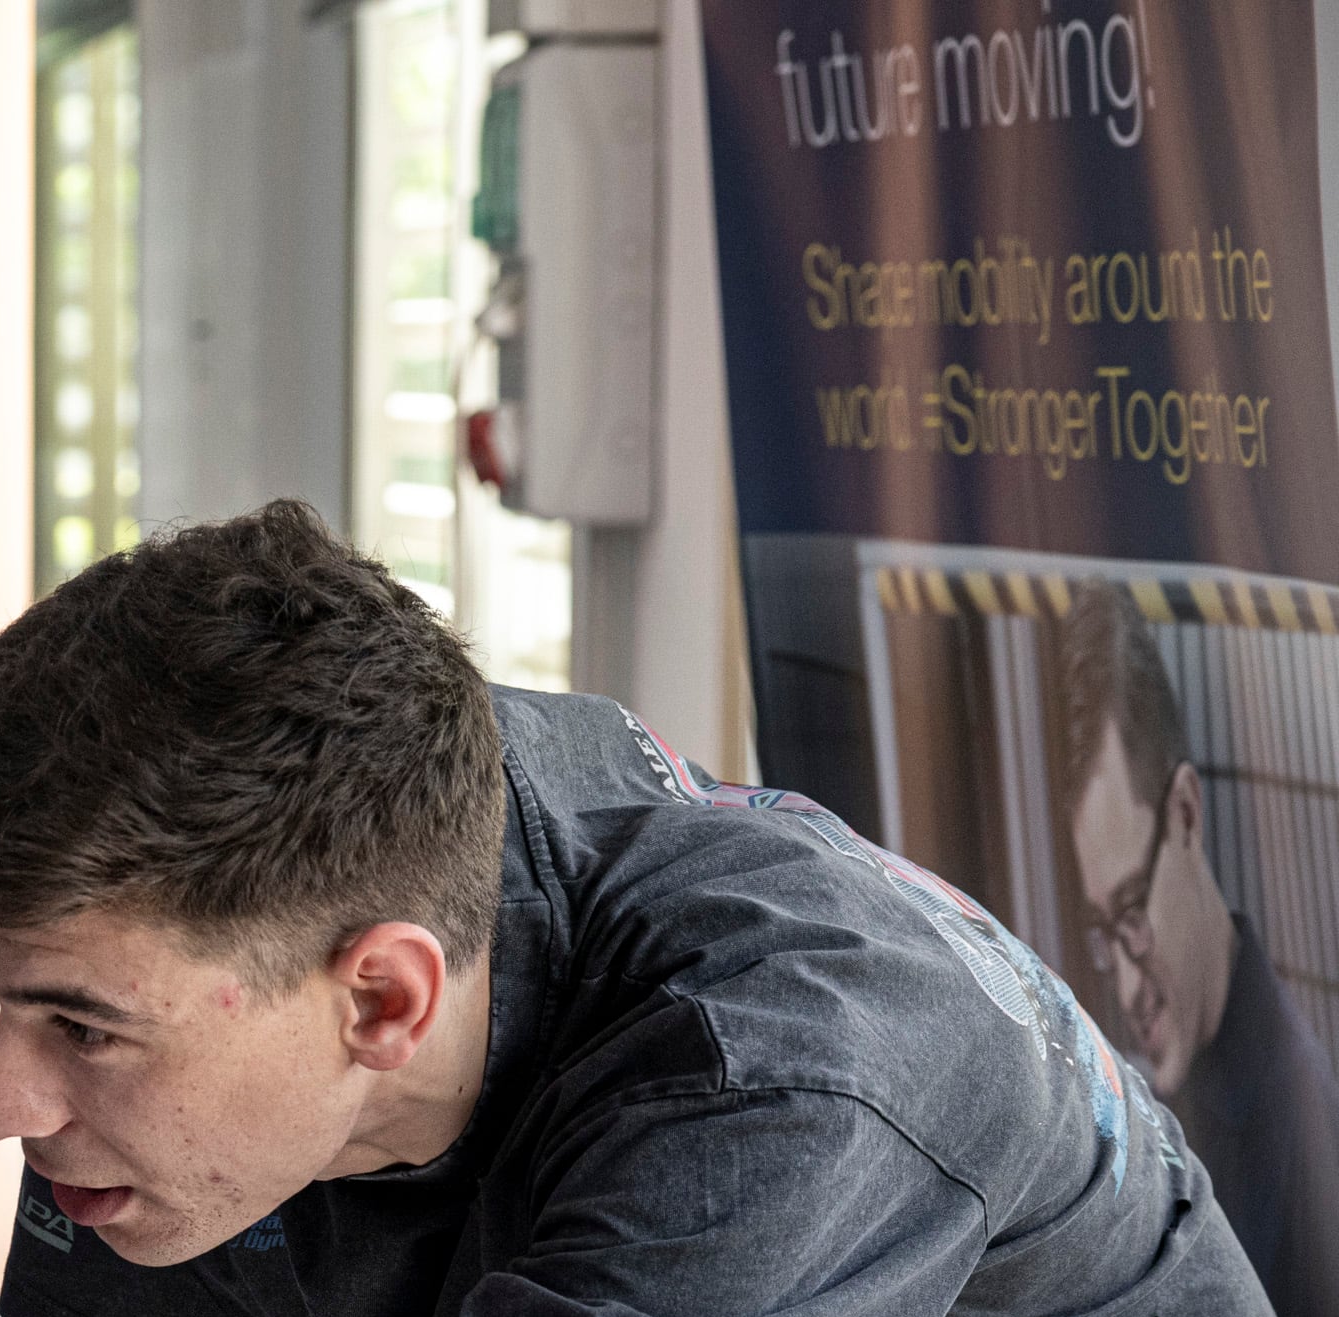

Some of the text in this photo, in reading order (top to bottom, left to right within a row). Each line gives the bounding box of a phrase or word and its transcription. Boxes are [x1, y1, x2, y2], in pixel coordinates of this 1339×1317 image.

[776, 0, 1155, 149] future moving!
[1065, 227, 1206, 325] around
[1212, 225, 1273, 323] the
